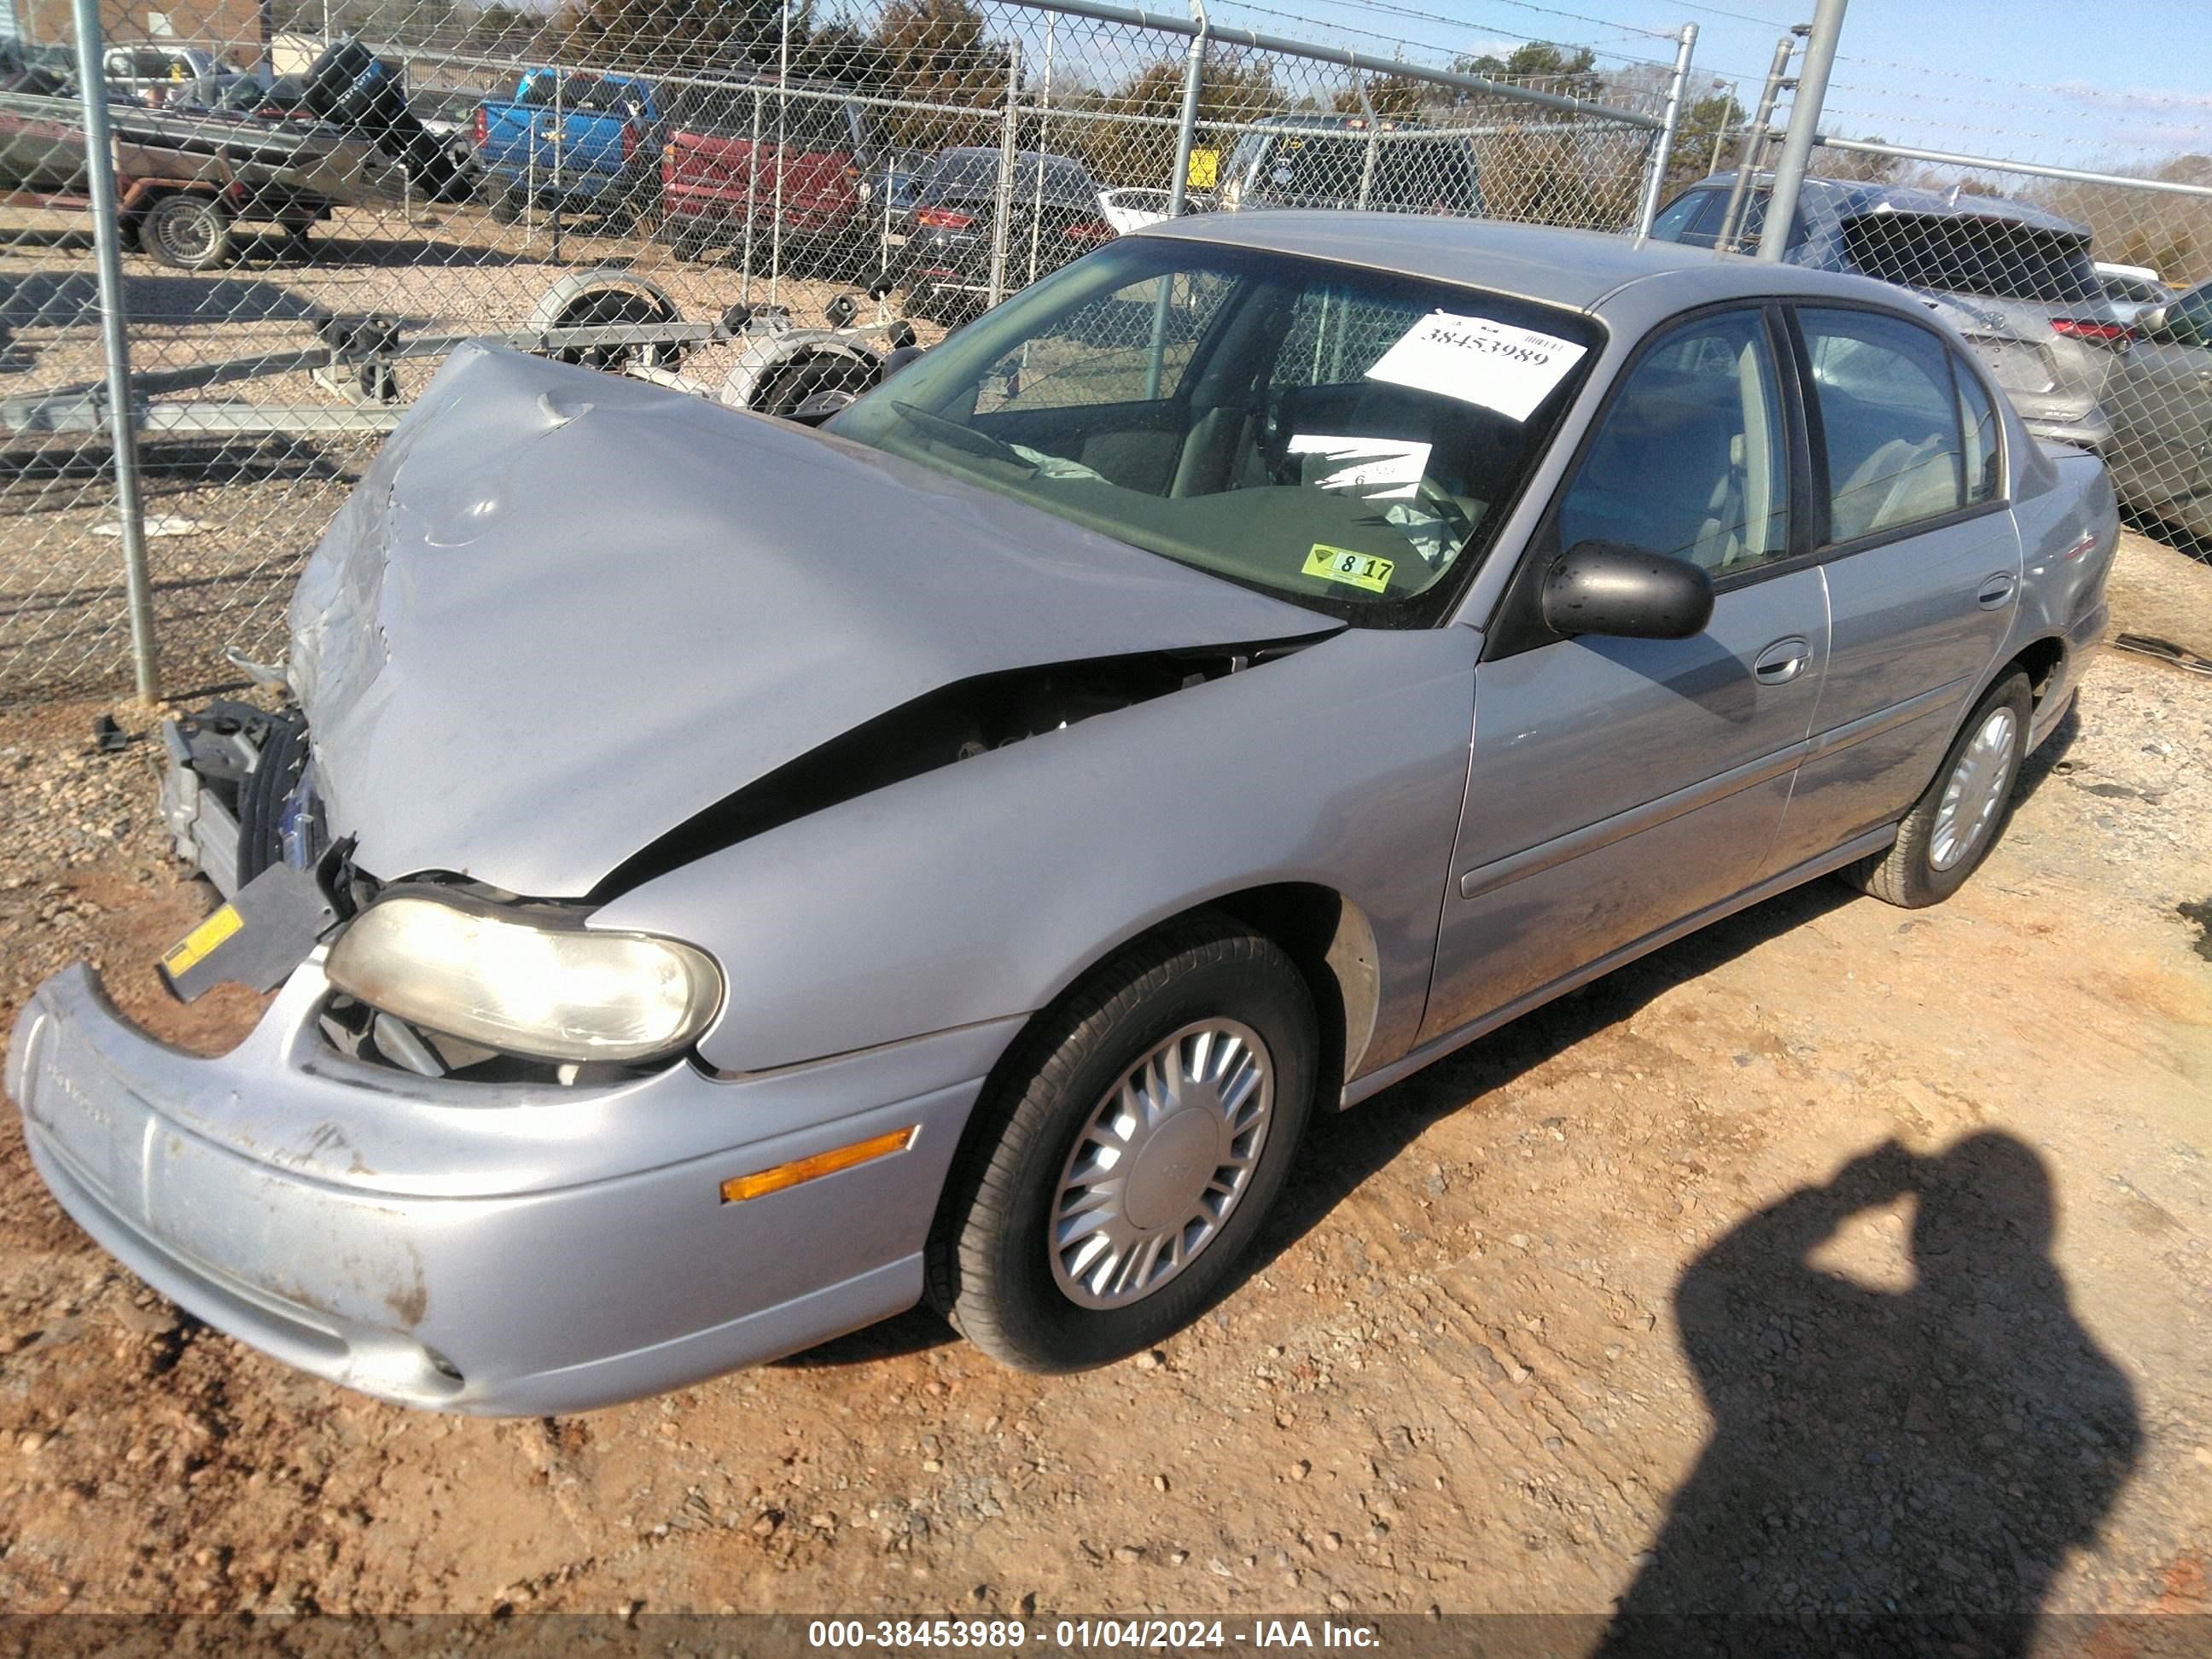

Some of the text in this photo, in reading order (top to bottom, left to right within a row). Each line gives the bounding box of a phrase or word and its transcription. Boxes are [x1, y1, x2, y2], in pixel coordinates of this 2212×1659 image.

[1421, 329, 1549, 365] 38453989
[1341, 556, 1356, 573] 8
[1363, 560, 1393, 581] 17
